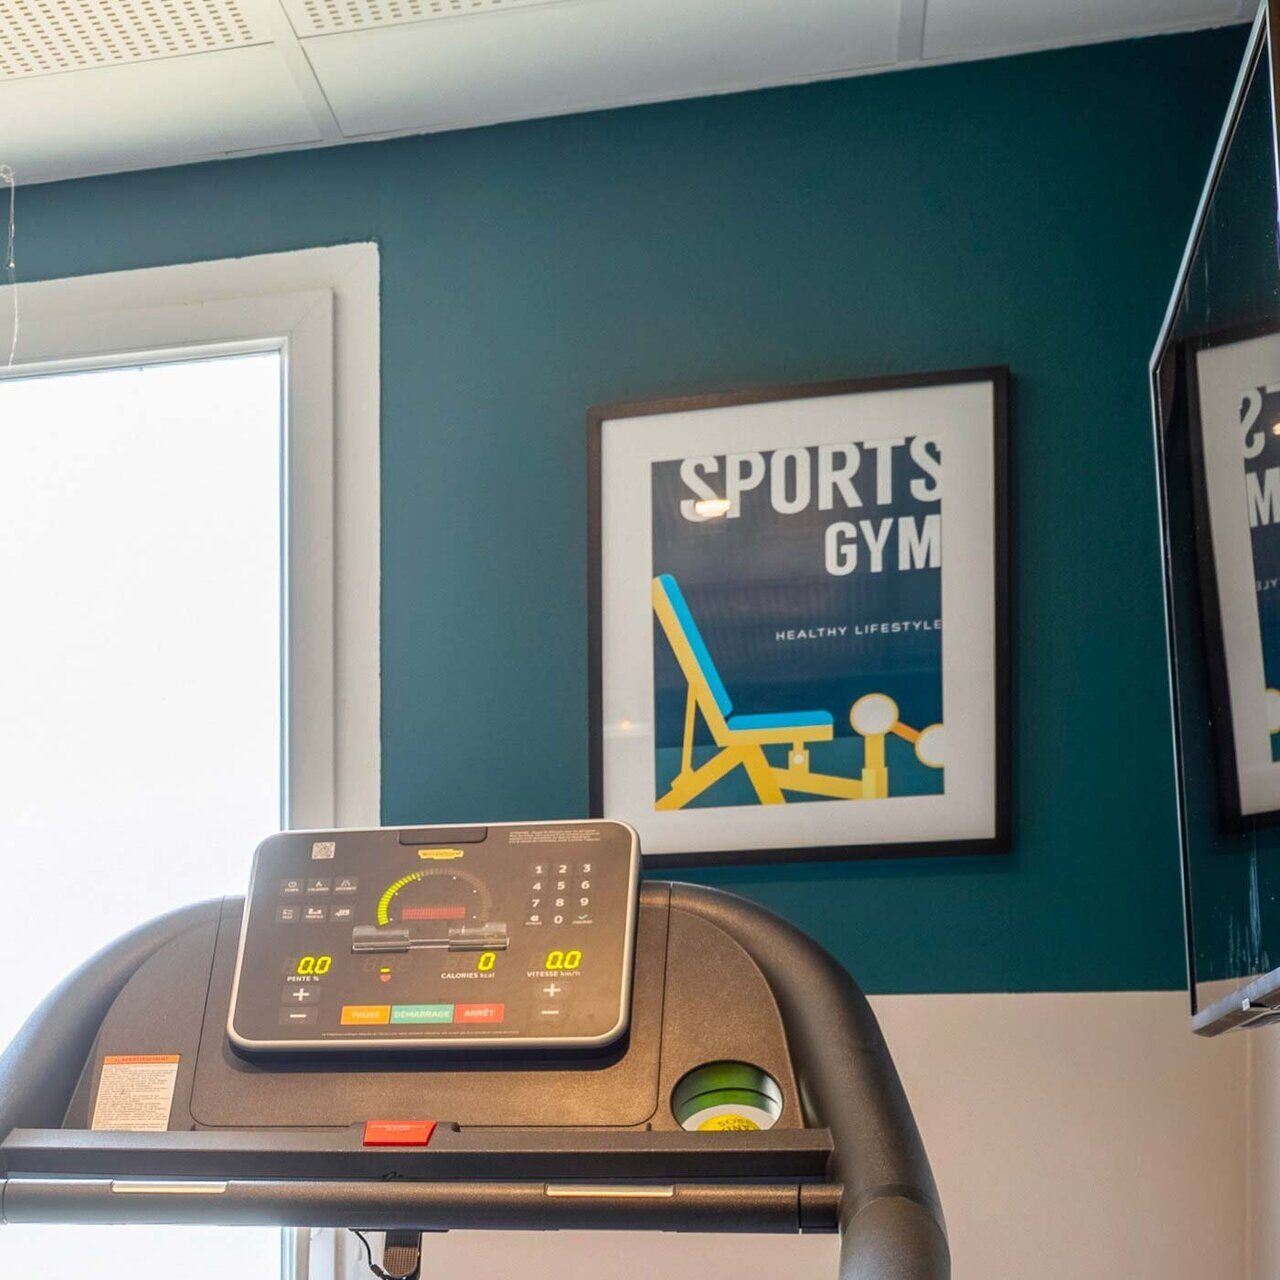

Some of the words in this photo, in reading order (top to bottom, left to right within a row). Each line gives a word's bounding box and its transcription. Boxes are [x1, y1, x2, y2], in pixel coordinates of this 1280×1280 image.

[680, 434, 942, 522] SPORTS
[825, 514, 941, 576] GYM
[776, 626, 847, 640] HEALTHY
[855, 619, 942, 635] LIFESTYLE
[535, 865, 542, 874] 1
[559, 864, 567, 873] 2
[583, 863, 591, 873] 3
[532, 882, 541, 890] 4
[557, 881, 565, 890] 5
[581, 880, 590, 889] 6
[532, 899, 540, 907] 7
[555, 898, 564, 907] 8
[580, 897, 589, 906] 9
[554, 915, 563, 924] 0
[478, 952, 496, 971] 0
[351, 1011, 380, 1019] PAUSE
